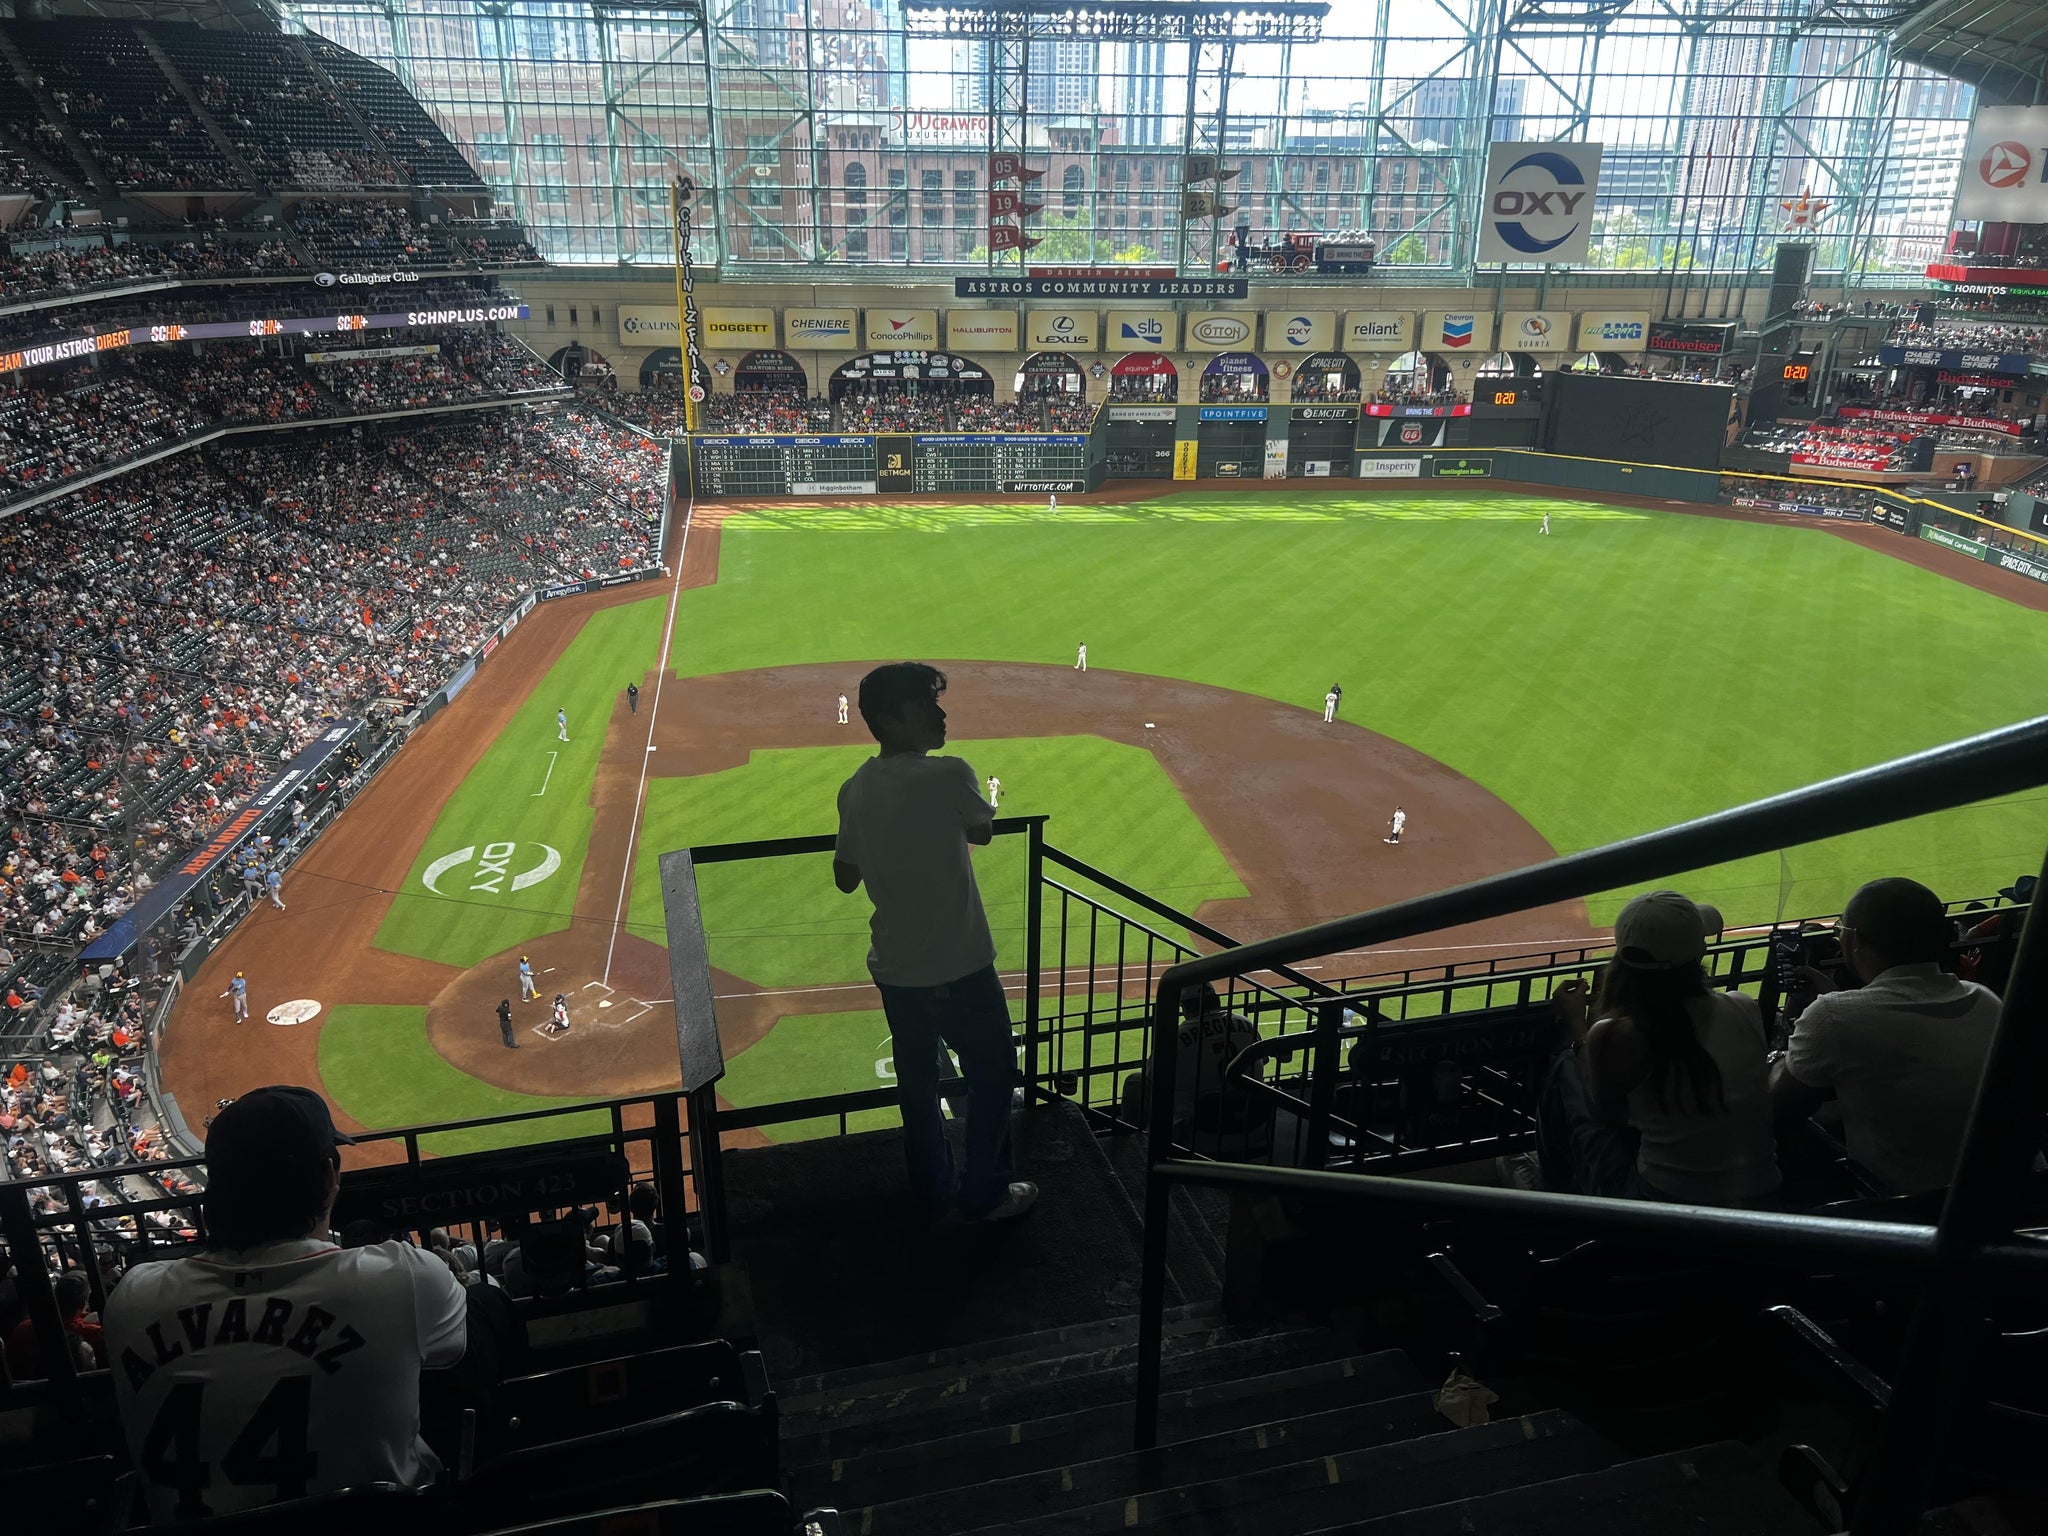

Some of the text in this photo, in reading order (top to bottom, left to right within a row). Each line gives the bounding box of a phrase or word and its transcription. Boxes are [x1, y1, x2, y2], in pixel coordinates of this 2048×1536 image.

[995, 159, 1012, 174] 05
[1193, 161, 1209, 176] 17
[996, 197, 1012, 210] 19
[1190, 200, 1206, 212] 22
[1493, 191, 1586, 216] OXY
[995, 230, 1010, 244] 21
[339, 271, 419, 286] Gallagher Club
[967, 282, 1235, 294] ASTROS COMMUNITY LEADERS
[1954, 284, 2007, 295] HORNITOS
[2009, 287, 2036, 295] TEQUILA
[337, 315, 368, 331] SCHN+
[407, 307, 518, 326] SCHNPLUS.COM
[250, 319, 283, 336] SCHN+
[709, 324, 768, 332] DOGGETT
[791, 319, 850, 329] CHENIERE
[1138, 318, 1163, 334] slb
[1354, 322, 1399, 335] reliant
[1584, 322, 1643, 339] FREEPORT LNG
[150, 324, 188, 342] SCHN+
[870, 331, 933, 341] ConocoPhillips
[1200, 324, 1241, 339] COTTON
[1036, 335, 1088, 344] LEXUS
[1650, 336, 1721, 352] Budweiser
[23, 346, 53, 367] YOUR
[55, 337, 95, 360] ASTROS
[96, 330, 130, 350] DIRECT
[686, 326, 700, 385] FAIR
[1220, 356, 1247, 366] planet
[1311, 358, 1347, 368] SPACE CITY
[1915, 357, 1941, 365] FIGHT
[1973, 361, 1998, 369] FIGHT
[1124, 365, 1150, 373] equinor
[1223, 364, 1252, 373] fitness
[1783, 365, 1808, 379] 0:20
[1936, 371, 2014, 388] Budweiser
[1494, 392, 1516, 405] 0:20
[1204, 410, 1264, 418] 1POINTFIVE
[1312, 409, 1347, 418] EMCJET
[1873, 410, 1930, 423] Budweiser
[1962, 417, 2009, 432] Budweiser
[1404, 430, 1418, 439] 66
[673, 438, 687, 446] 315
[1376, 461, 1416, 472] Insperity
[1818, 456, 1874, 470] Budweiser
[1014, 482, 1073, 491] NITTOTIRE.COM
[2000, 554, 2019, 571] SPACE
[2018, 560, 2031, 576] CITY
[546, 584, 582, 599] AmegyBank
[178, 808, 262, 876] DAIKIN PARK
[469, 841, 516, 894] OXY
[382, 1173, 576, 1218] SECTION 423
[120, 1297, 367, 1394] ALVAREZ
[141, 1374, 320, 1523] 44
